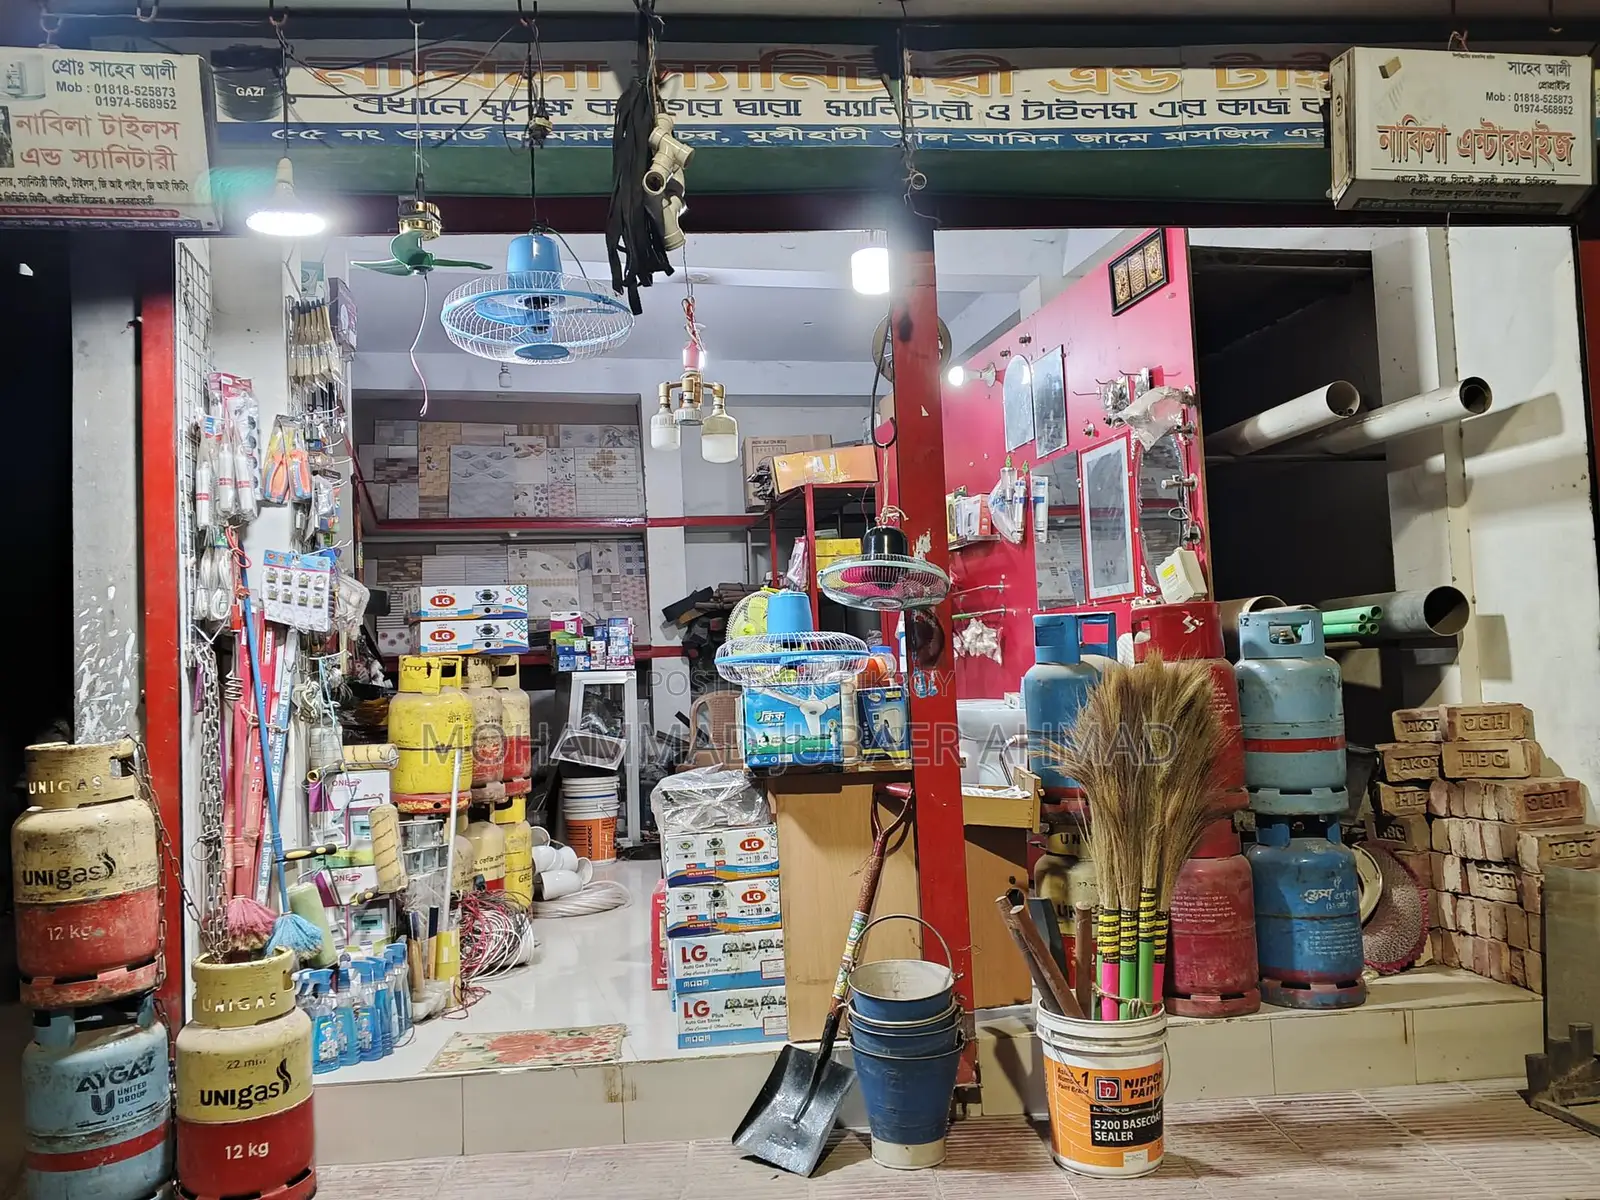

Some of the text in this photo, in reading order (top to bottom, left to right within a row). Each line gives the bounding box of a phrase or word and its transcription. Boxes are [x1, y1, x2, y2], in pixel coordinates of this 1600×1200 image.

[90, 60, 136, 80] সাহেব
[141, 60, 177, 80] আলী
[1508, 60, 1571, 77] সাহেব আলী
[56, 81, 83, 93] Mob
[94, 84, 176, 98] 01818-525873
[236, 86, 266, 97] GAZI
[95, 96, 177, 110] 01974-568952
[1486, 92, 1505, 102] Mob
[1514, 93, 1573, 105] 01818-525873
[985, 104, 1010, 121] ও
[1021, 99, 1138, 121] টাইলস
[1149, 99, 1207, 118] এর
[1216, 98, 1291, 116] কাজ
[1514, 104, 1573, 115] 01974-568952
[13, 110, 181, 142] নাবিলা টাইলস
[336, 129, 385, 142] নং
[1071, 132, 1153, 145] জামে
[1377, 114, 1451, 164] নাবিলা
[20, 145, 178, 173] এন্ড স্যানিটারী
[434, 597, 451, 606] LG
[434, 632, 451, 641] LG
[1461, 751, 1507, 768] HBC
[28, 776, 104, 795] UNIGAS
[745, 840, 760, 850] LG
[746, 892, 761, 901] LG
[47, 924, 94, 942] 12 kg
[681, 944, 709, 964] LG
[202, 991, 277, 1013] UNIGAS
[683, 1000, 711, 1019] LG
[1081, 1071, 1090, 1088] 1
[117, 1081, 147, 1097] UNITED
[200, 1082, 280, 1110] UNIgas
[1130, 1082, 1161, 1100] PAINT
[1093, 1111, 1162, 1130] 5200 BASECOAT
[1094, 1131, 1134, 1142] SEALER
[225, 1142, 269, 1160] 12 kg
